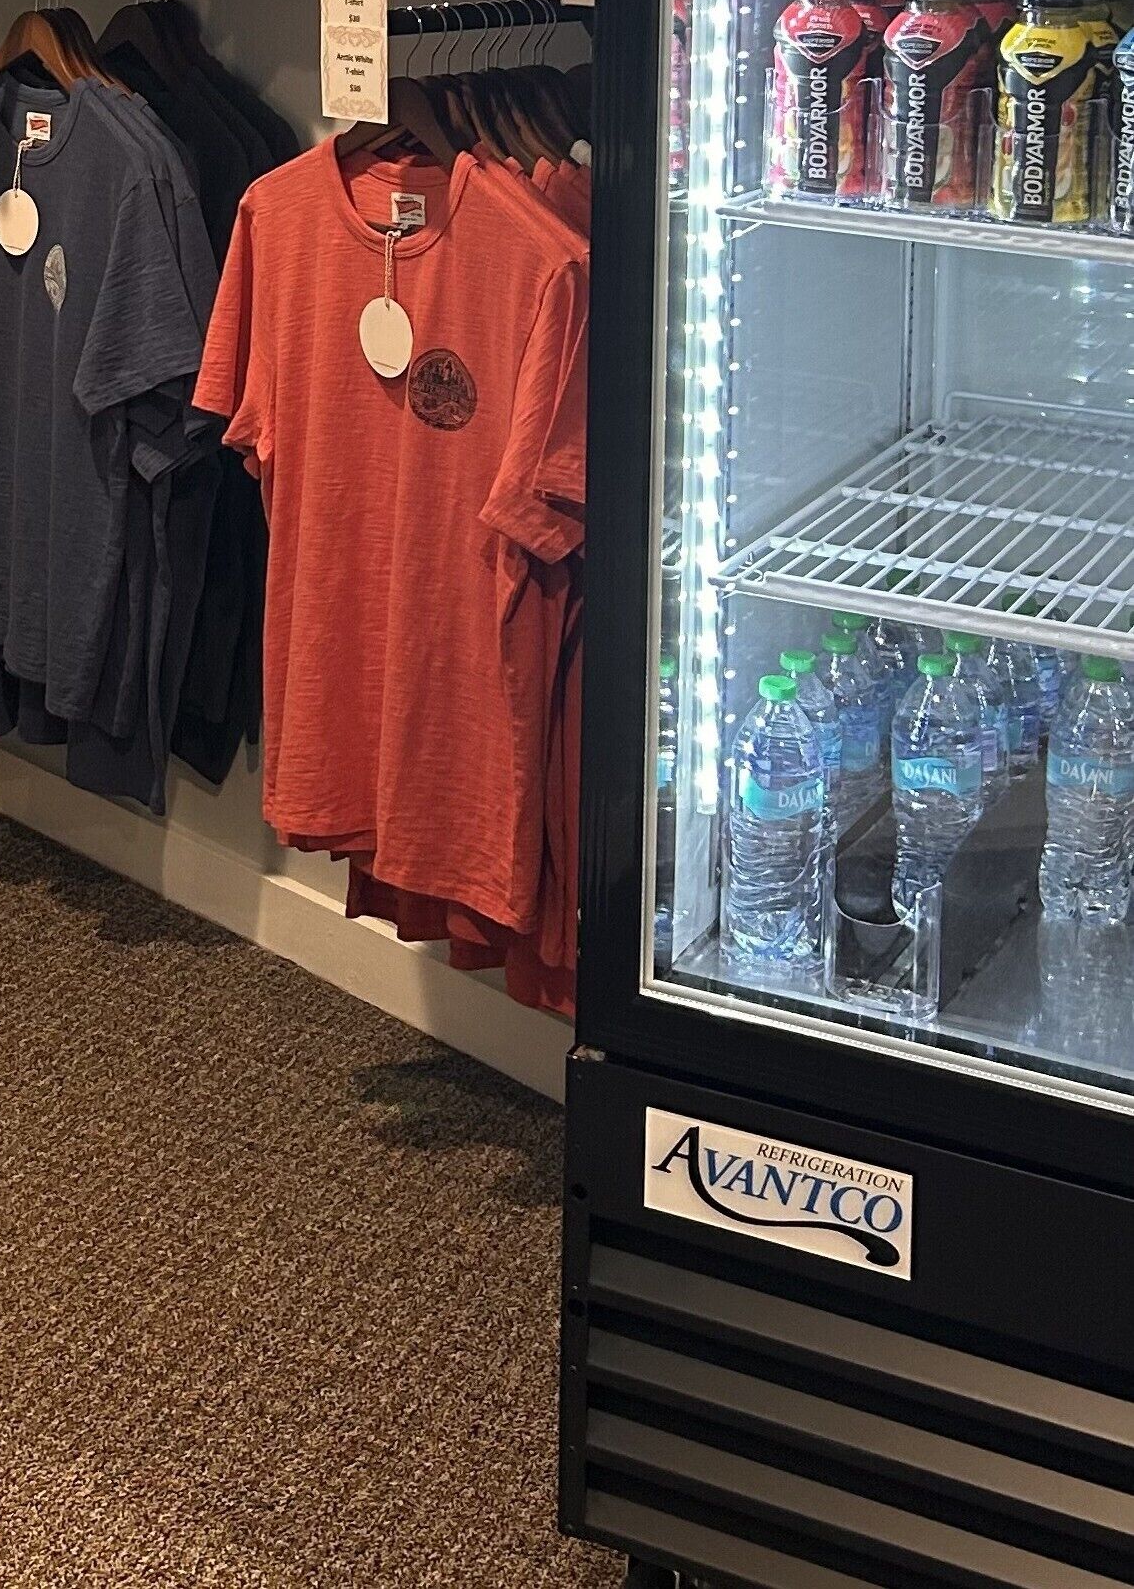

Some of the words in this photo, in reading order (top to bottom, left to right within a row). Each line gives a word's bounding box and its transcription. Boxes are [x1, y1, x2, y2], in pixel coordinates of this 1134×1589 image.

[808, 67, 828, 180] BODYARMOR
[905, 72, 927, 188] BODYARMOR
[1023, 88, 1046, 206] BODYARMOR
[778, 788, 823, 808] DASAN
[902, 760, 958, 786] DASANI
[1060, 759, 1114, 786] DASANI
[652, 1126, 903, 1234] AVANTCO
[756, 1142, 906, 1193] REFRIGERATION
